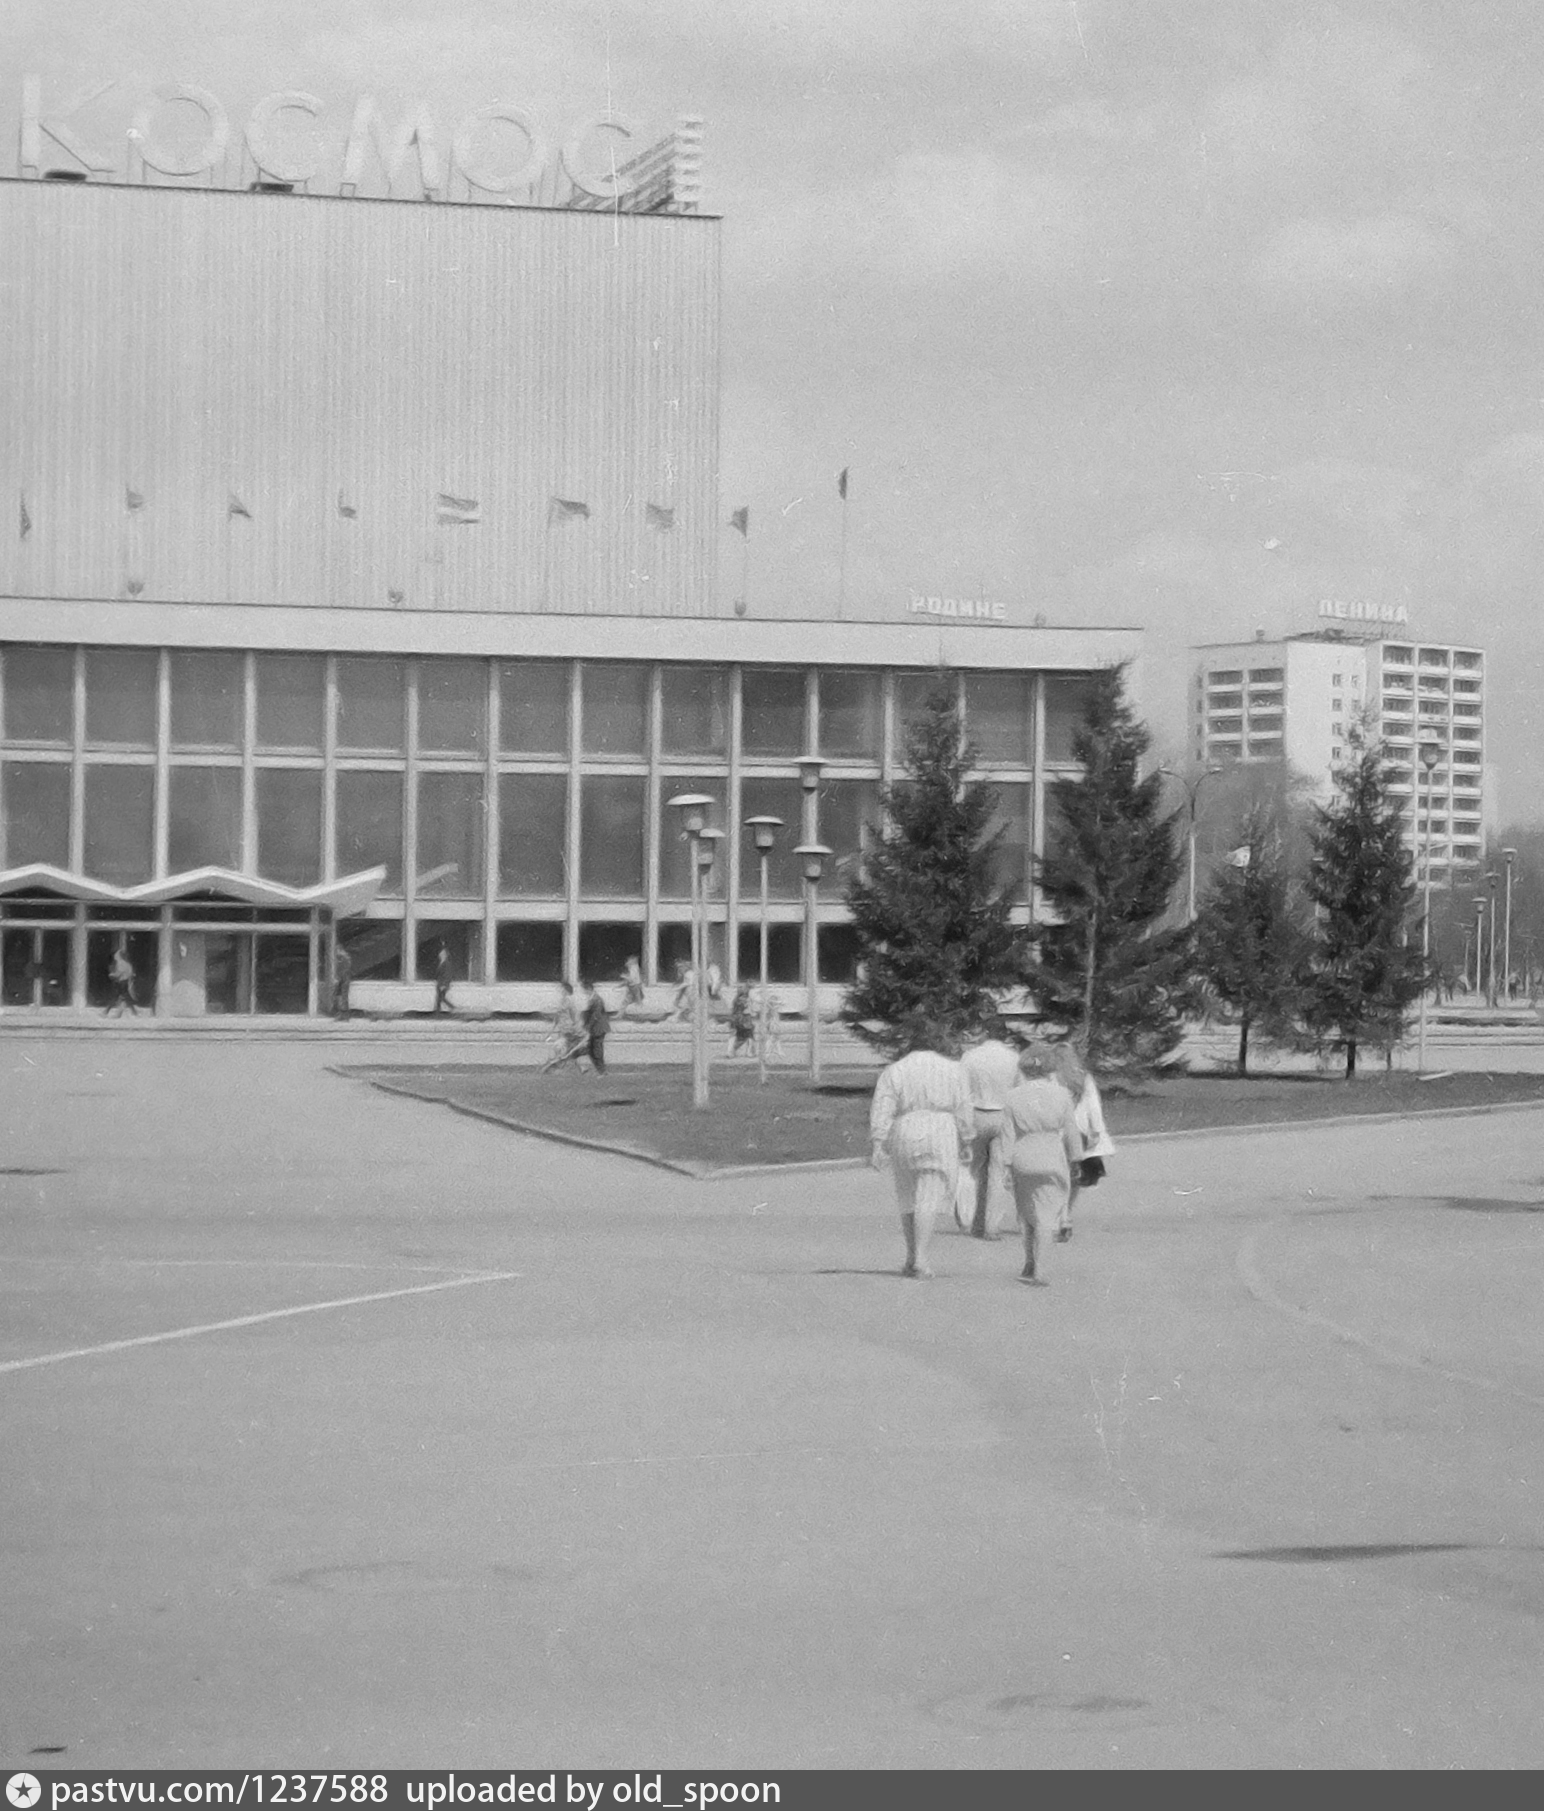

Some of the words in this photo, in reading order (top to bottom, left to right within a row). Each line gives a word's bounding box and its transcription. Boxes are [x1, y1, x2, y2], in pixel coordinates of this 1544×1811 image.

[19, 73, 636, 197] КОСМОС
[911, 596, 1006, 619] РОДИНЕ
[1318, 599, 1408, 622] ЛЕНИНА
